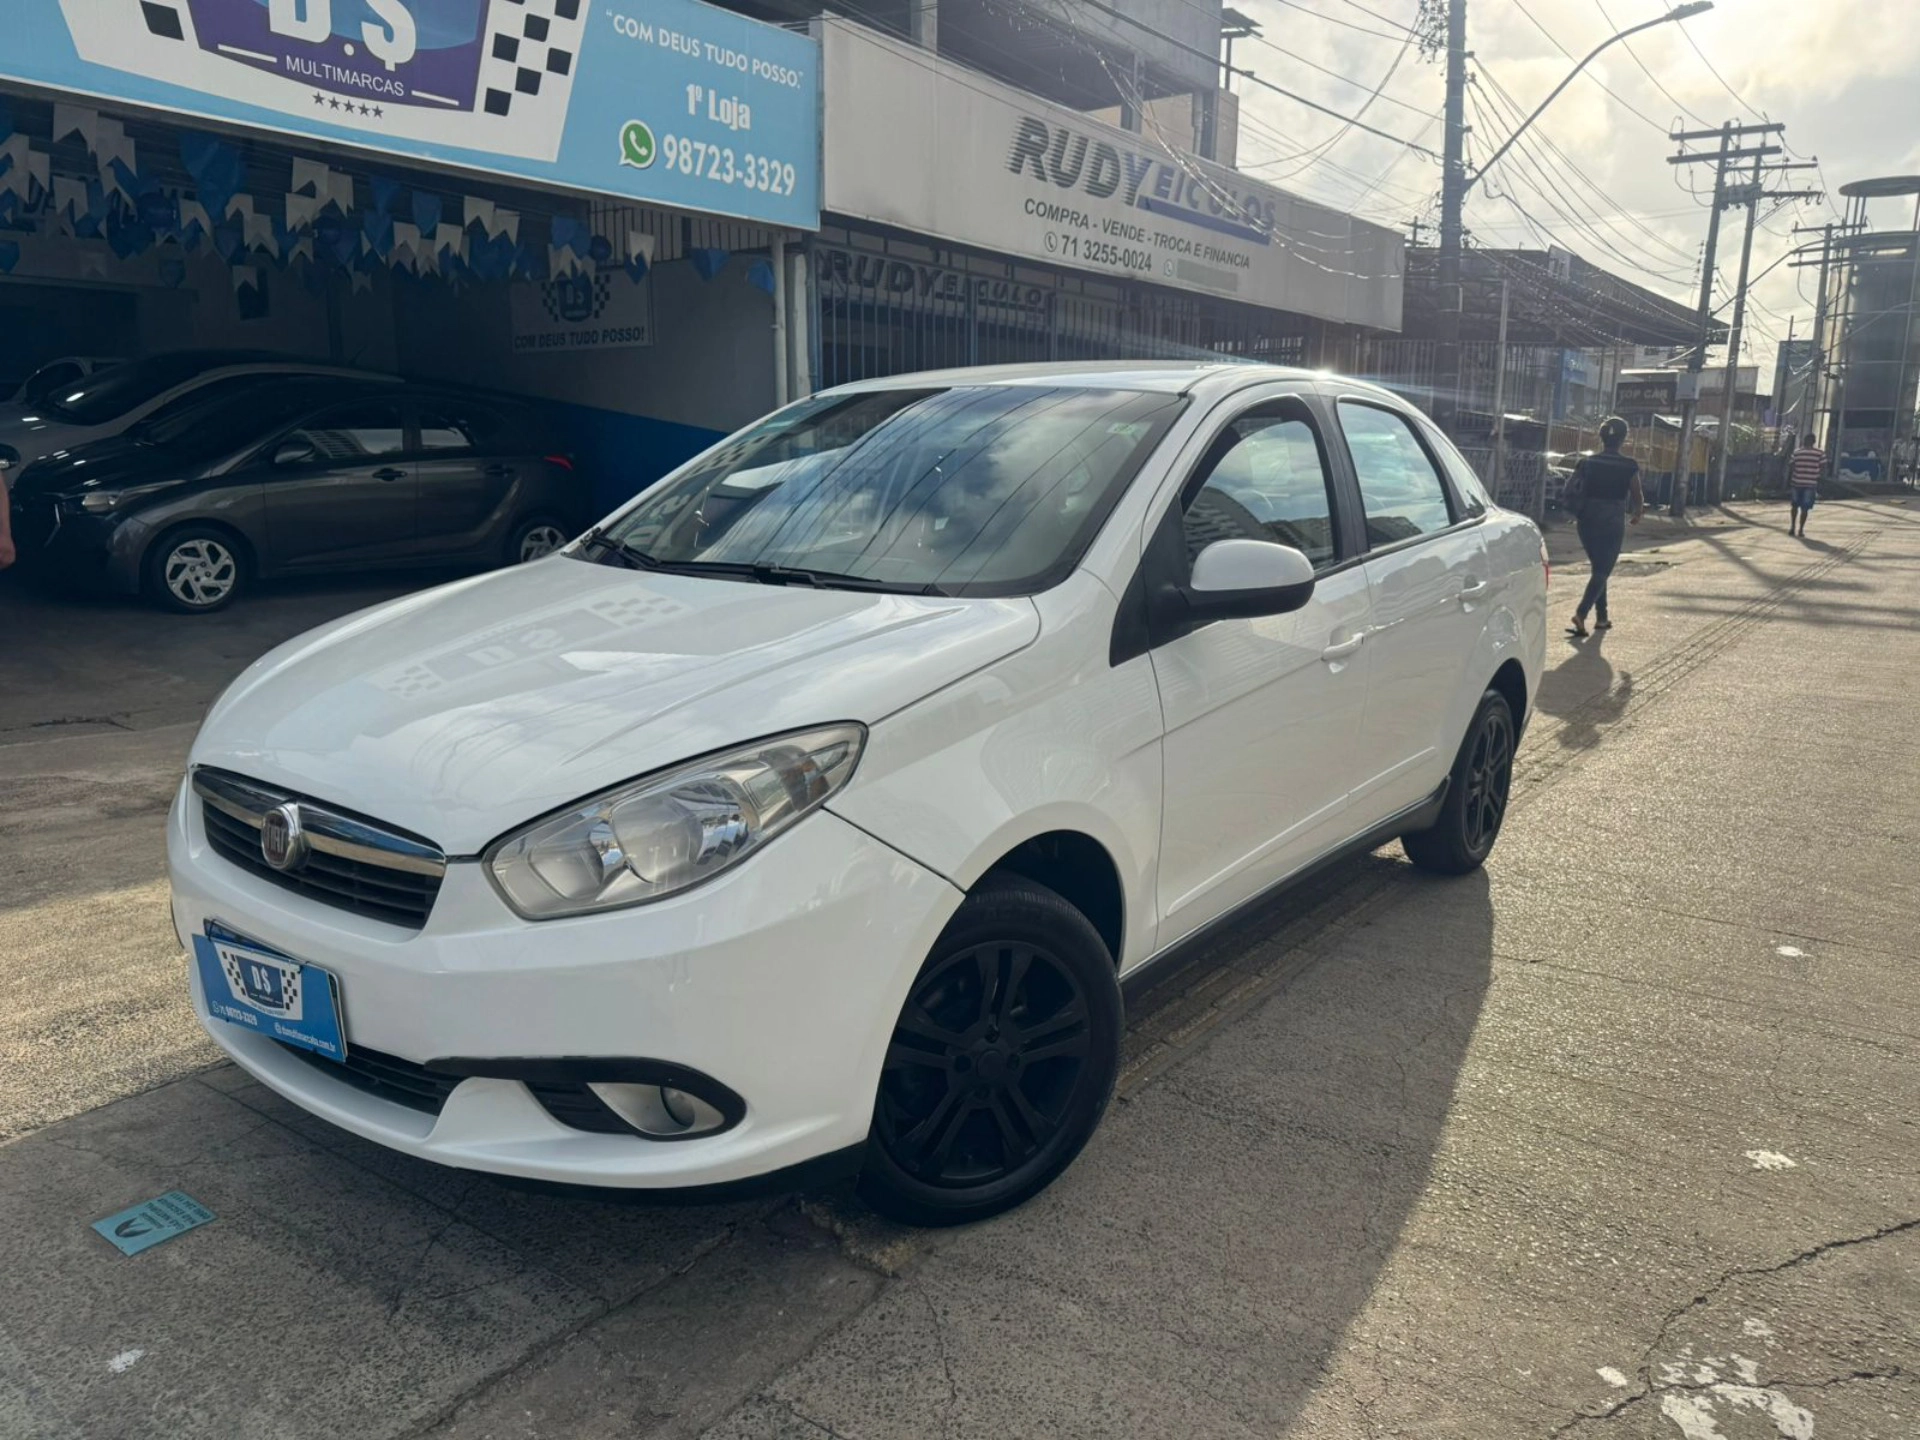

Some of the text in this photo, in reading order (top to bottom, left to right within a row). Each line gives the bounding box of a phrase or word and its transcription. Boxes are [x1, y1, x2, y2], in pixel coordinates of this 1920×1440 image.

[659, 28, 700, 57] DEUS
[704, 43, 748, 72] TUDO
[286, 55, 405, 97] MULTIMARCAS
[708, 89, 751, 131] Loja
[663, 134, 796, 196] 98723-3329
[1024, 198, 1089, 230] COMPRA
[1102, 218, 1145, 243] VENDE
[1153, 232, 1191, 254] TROCA
[1193, 243, 1202, 258] E
[1203, 246, 1250, 269] FINANCIA
[1062, 235, 1152, 271] 71 3255-0024
[514, 326, 645, 349] COM DEUS TUDO POSSO!
